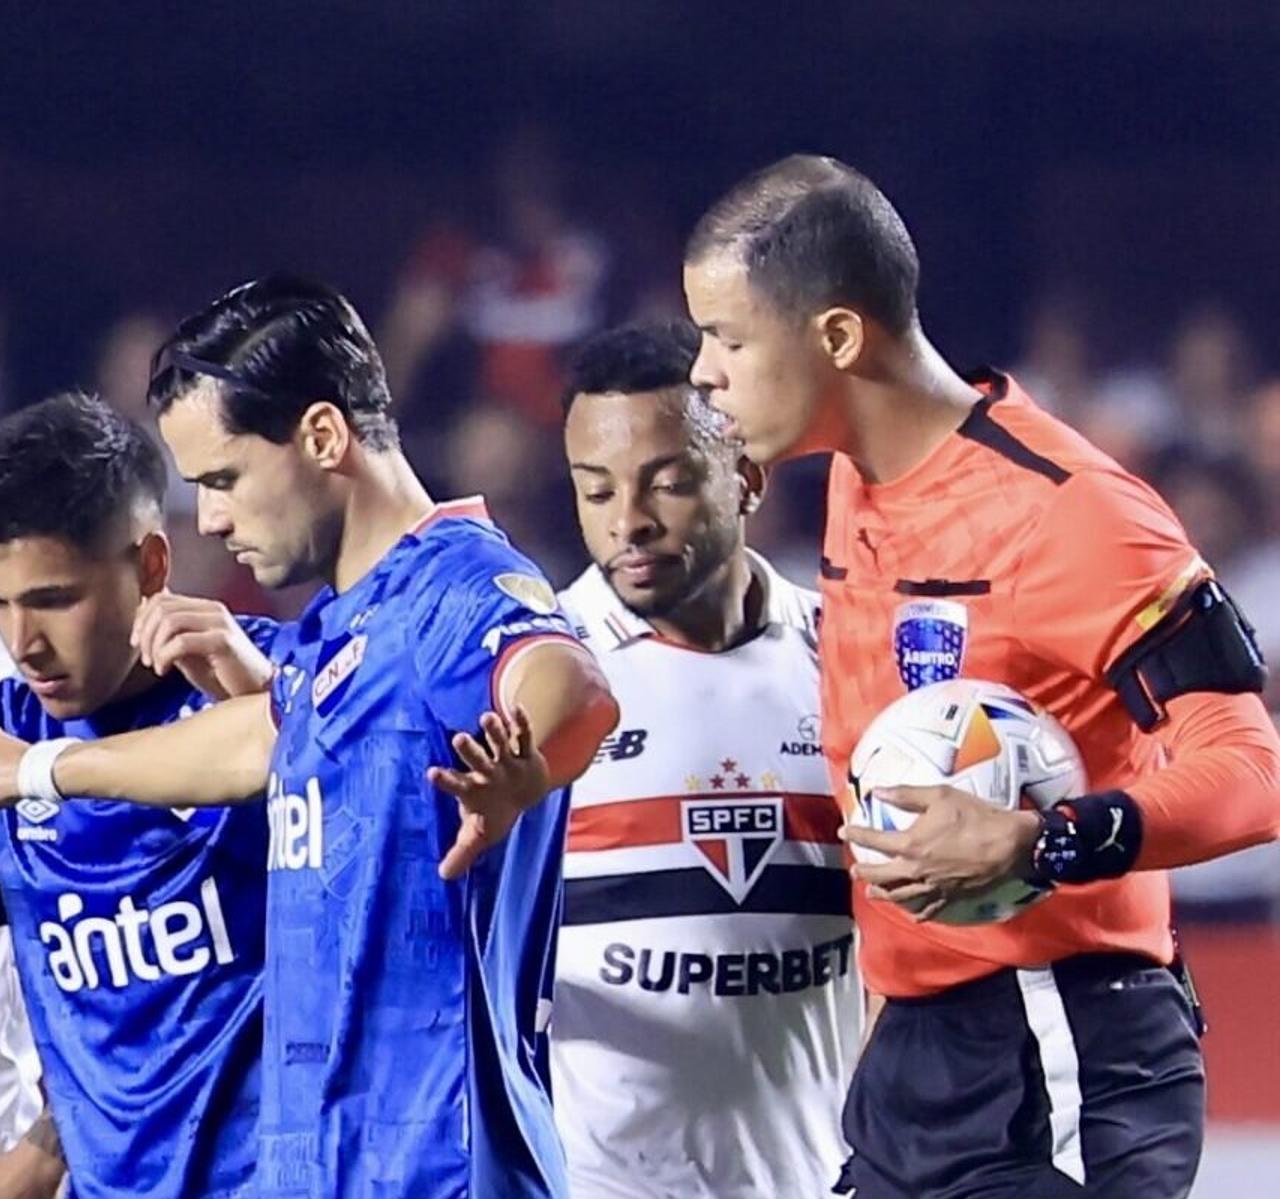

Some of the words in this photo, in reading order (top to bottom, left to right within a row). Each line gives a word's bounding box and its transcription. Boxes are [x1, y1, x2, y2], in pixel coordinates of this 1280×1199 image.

[691, 808, 774, 832] SPFC
[39, 875, 235, 993] antel
[599, 933, 854, 997] SUPERBET
